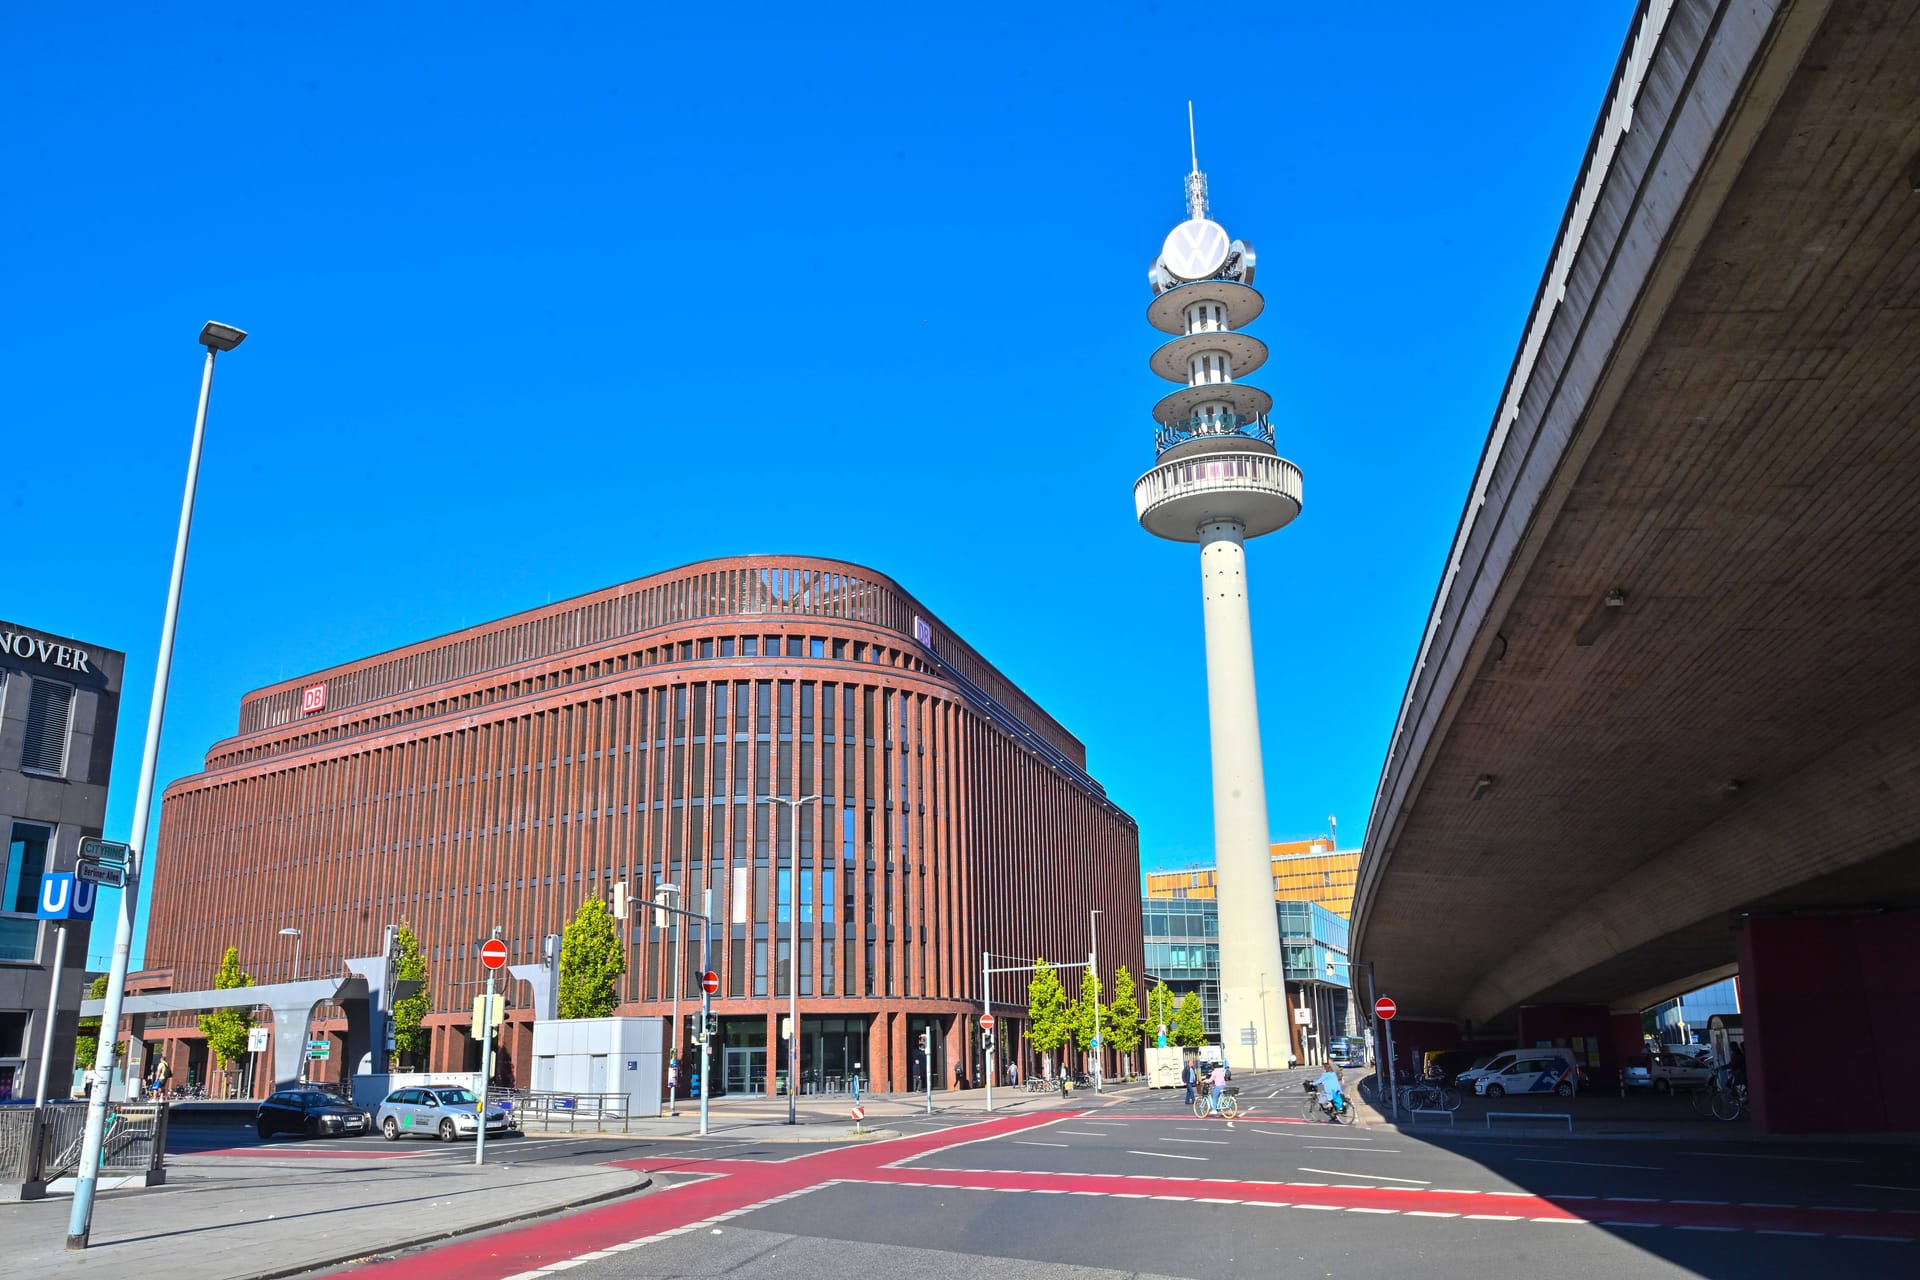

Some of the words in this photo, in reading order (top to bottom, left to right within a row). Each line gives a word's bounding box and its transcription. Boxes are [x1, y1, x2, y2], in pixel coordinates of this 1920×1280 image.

[0, 631, 90, 673] NOVER
[305, 689, 321, 708] DB
[85, 843, 124, 855] CITYRING
[84, 866, 105, 878] Berliner
[107, 869, 119, 881] Allee
[43, 880, 69, 912] U
[73, 881, 95, 913] U
